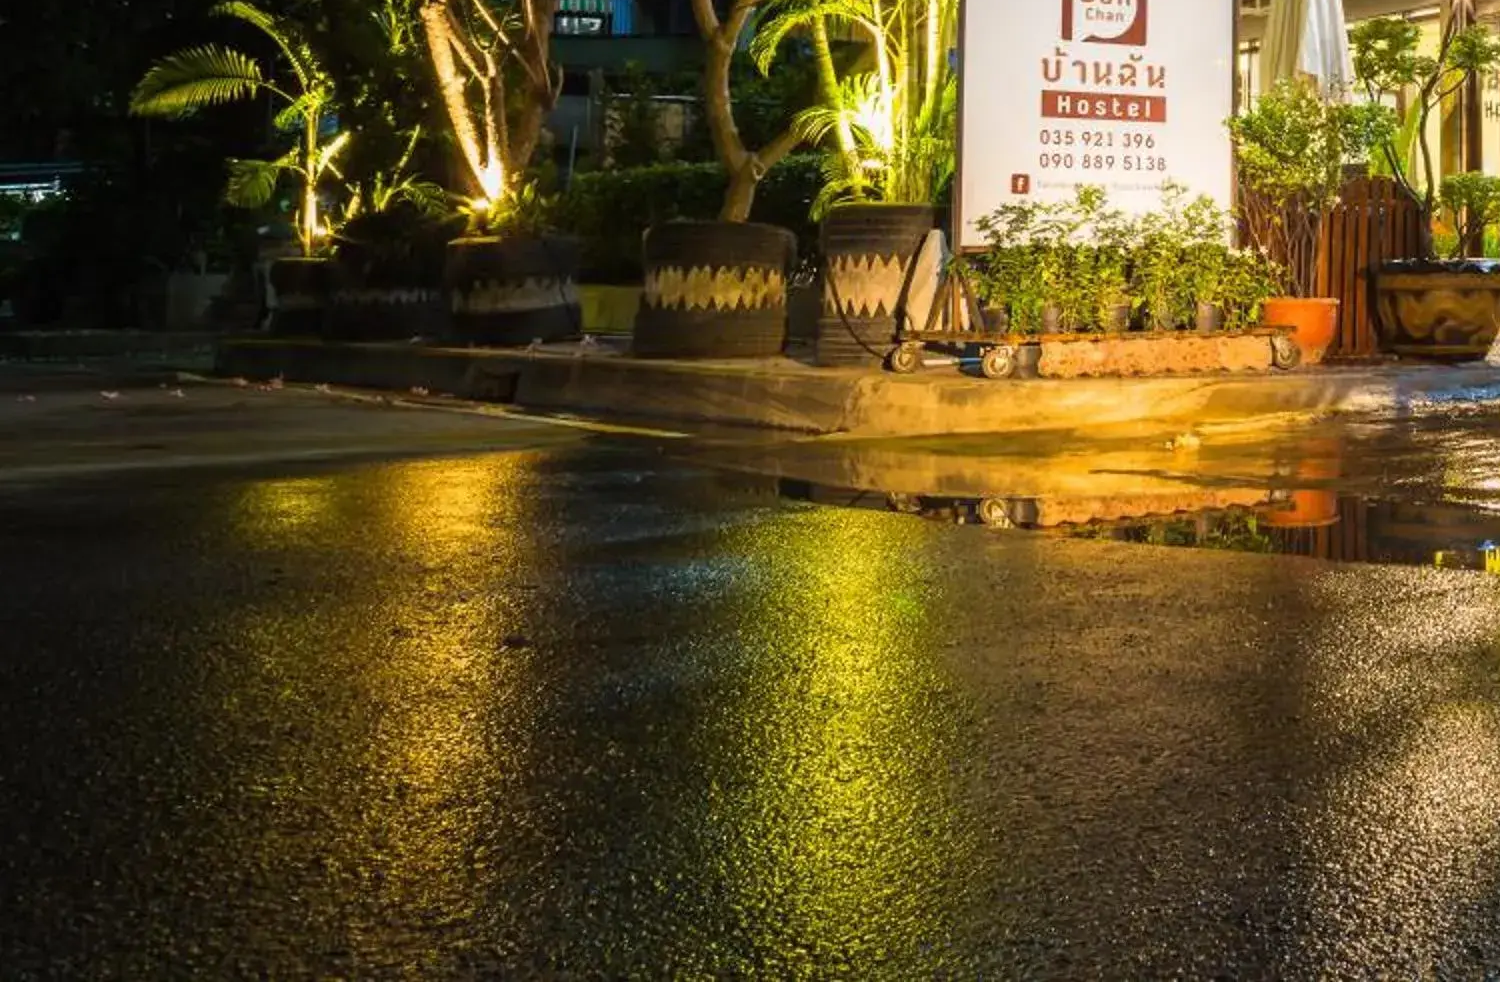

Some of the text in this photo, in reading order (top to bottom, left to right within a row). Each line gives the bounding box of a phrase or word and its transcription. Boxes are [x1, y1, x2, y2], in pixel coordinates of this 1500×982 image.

[1086, 7, 1126, 22] Chan
[1042, 47, 1166, 88] บ้านฉัน
[1057, 95, 1151, 118] Hostel
[1039, 129, 1155, 149] 035 921 396
[1039, 153, 1167, 171] 090 889 5138
